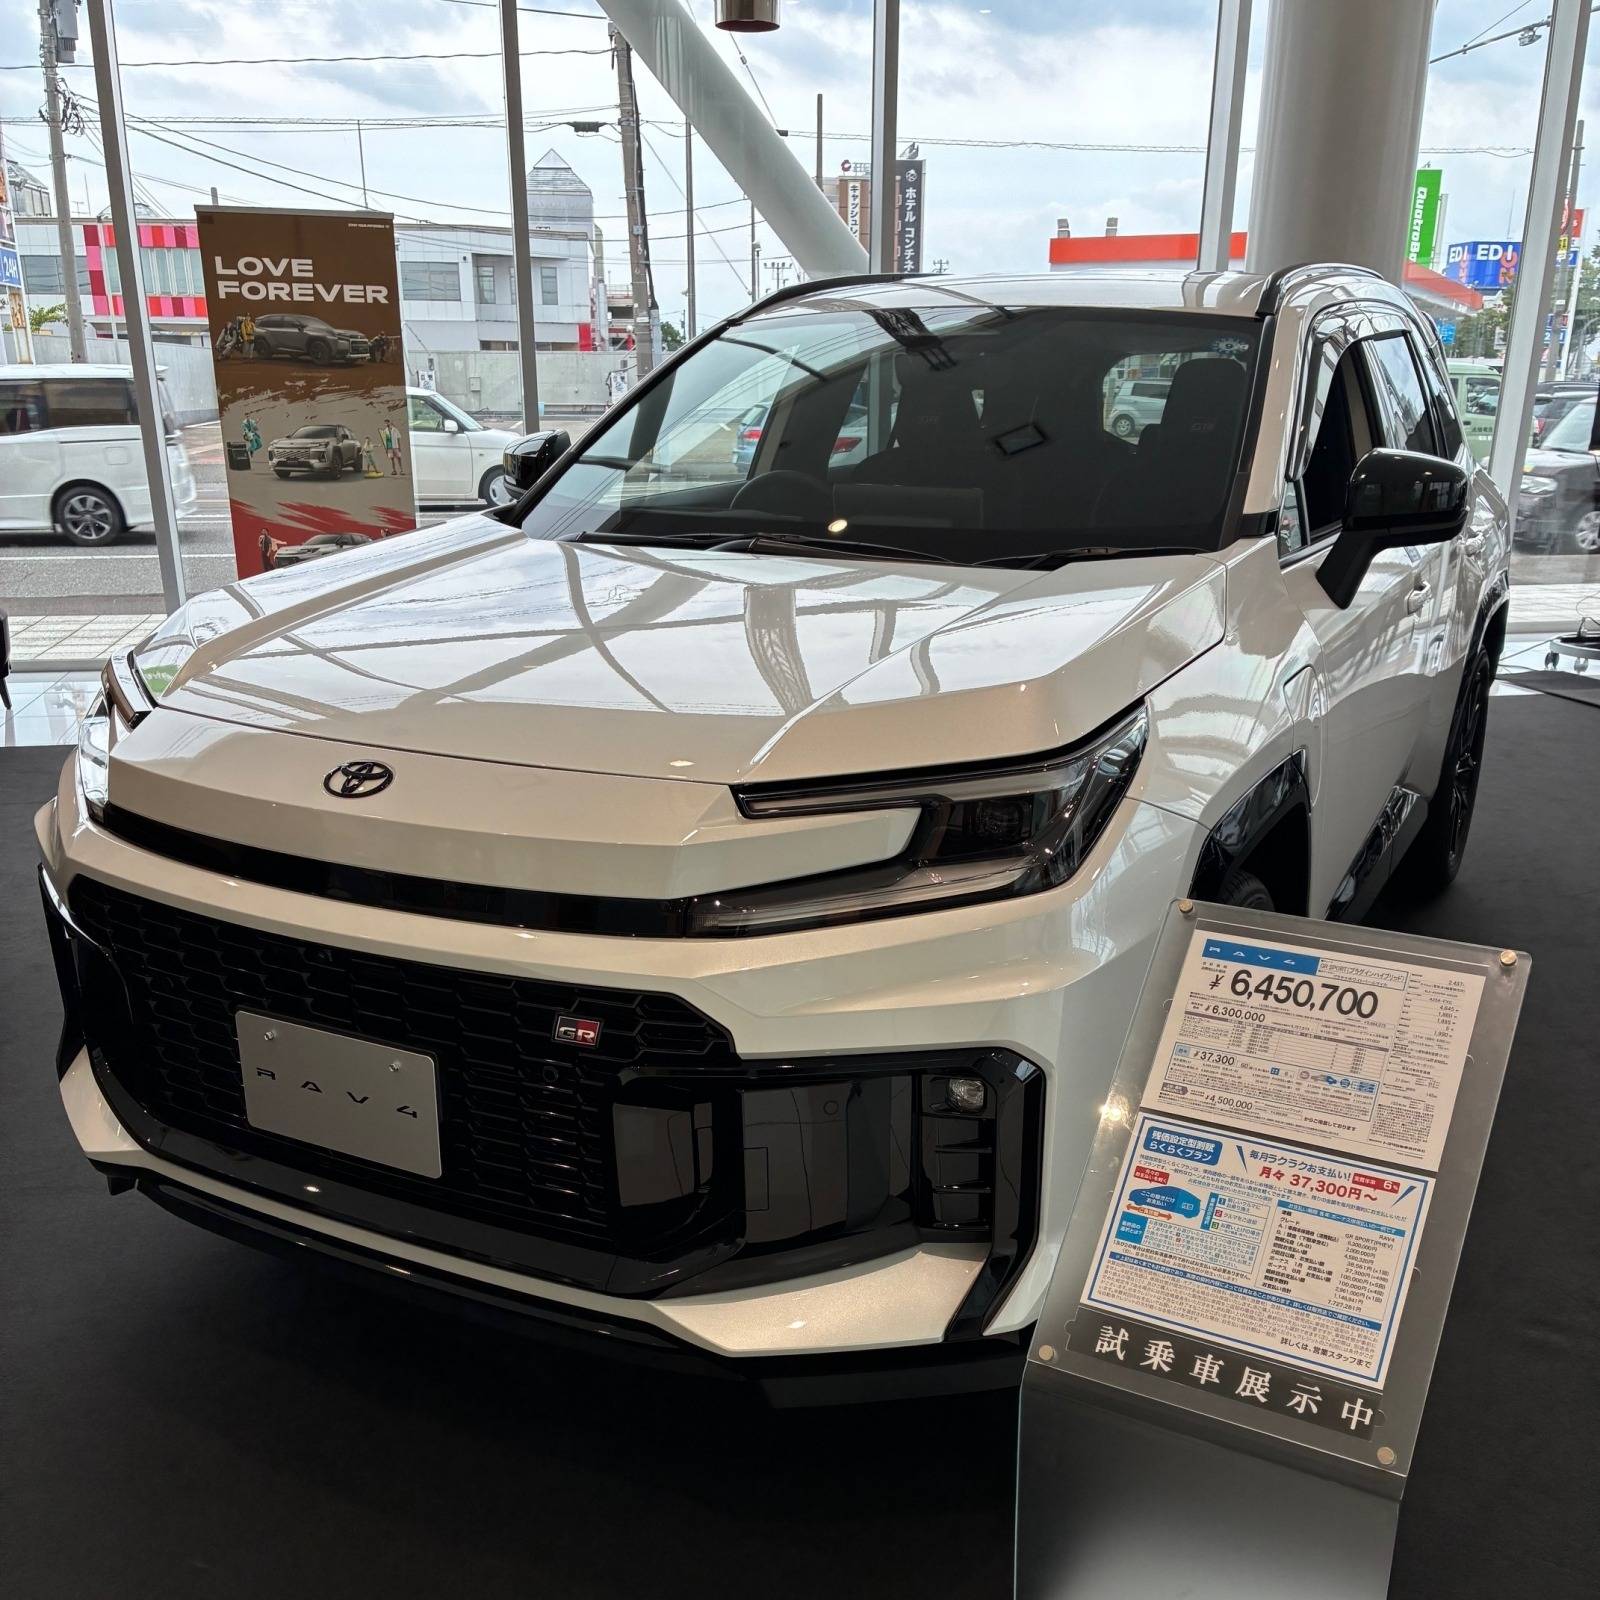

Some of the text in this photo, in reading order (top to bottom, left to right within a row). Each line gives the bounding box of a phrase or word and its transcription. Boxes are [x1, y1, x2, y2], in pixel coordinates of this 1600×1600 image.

[903, 187, 917, 274] ホテル コンチネ
[214, 255, 314, 278] LOVE
[217, 281, 389, 304] FOREVER
[1208, 945, 1296, 965] RAV4
[558, 1026, 595, 1043] GR
[256, 1067, 418, 1119] RAV4
[1148, 1140, 1212, 1162] らくらくプラン
[1150, 1129, 1215, 1152] 残価設定型割賦
[1258, 1167, 1283, 1181] 月々
[1279, 1336, 1371, 1369] 詳しくは、営業スタッフまで
[1095, 1325, 1374, 1432] 試乗車展示中
